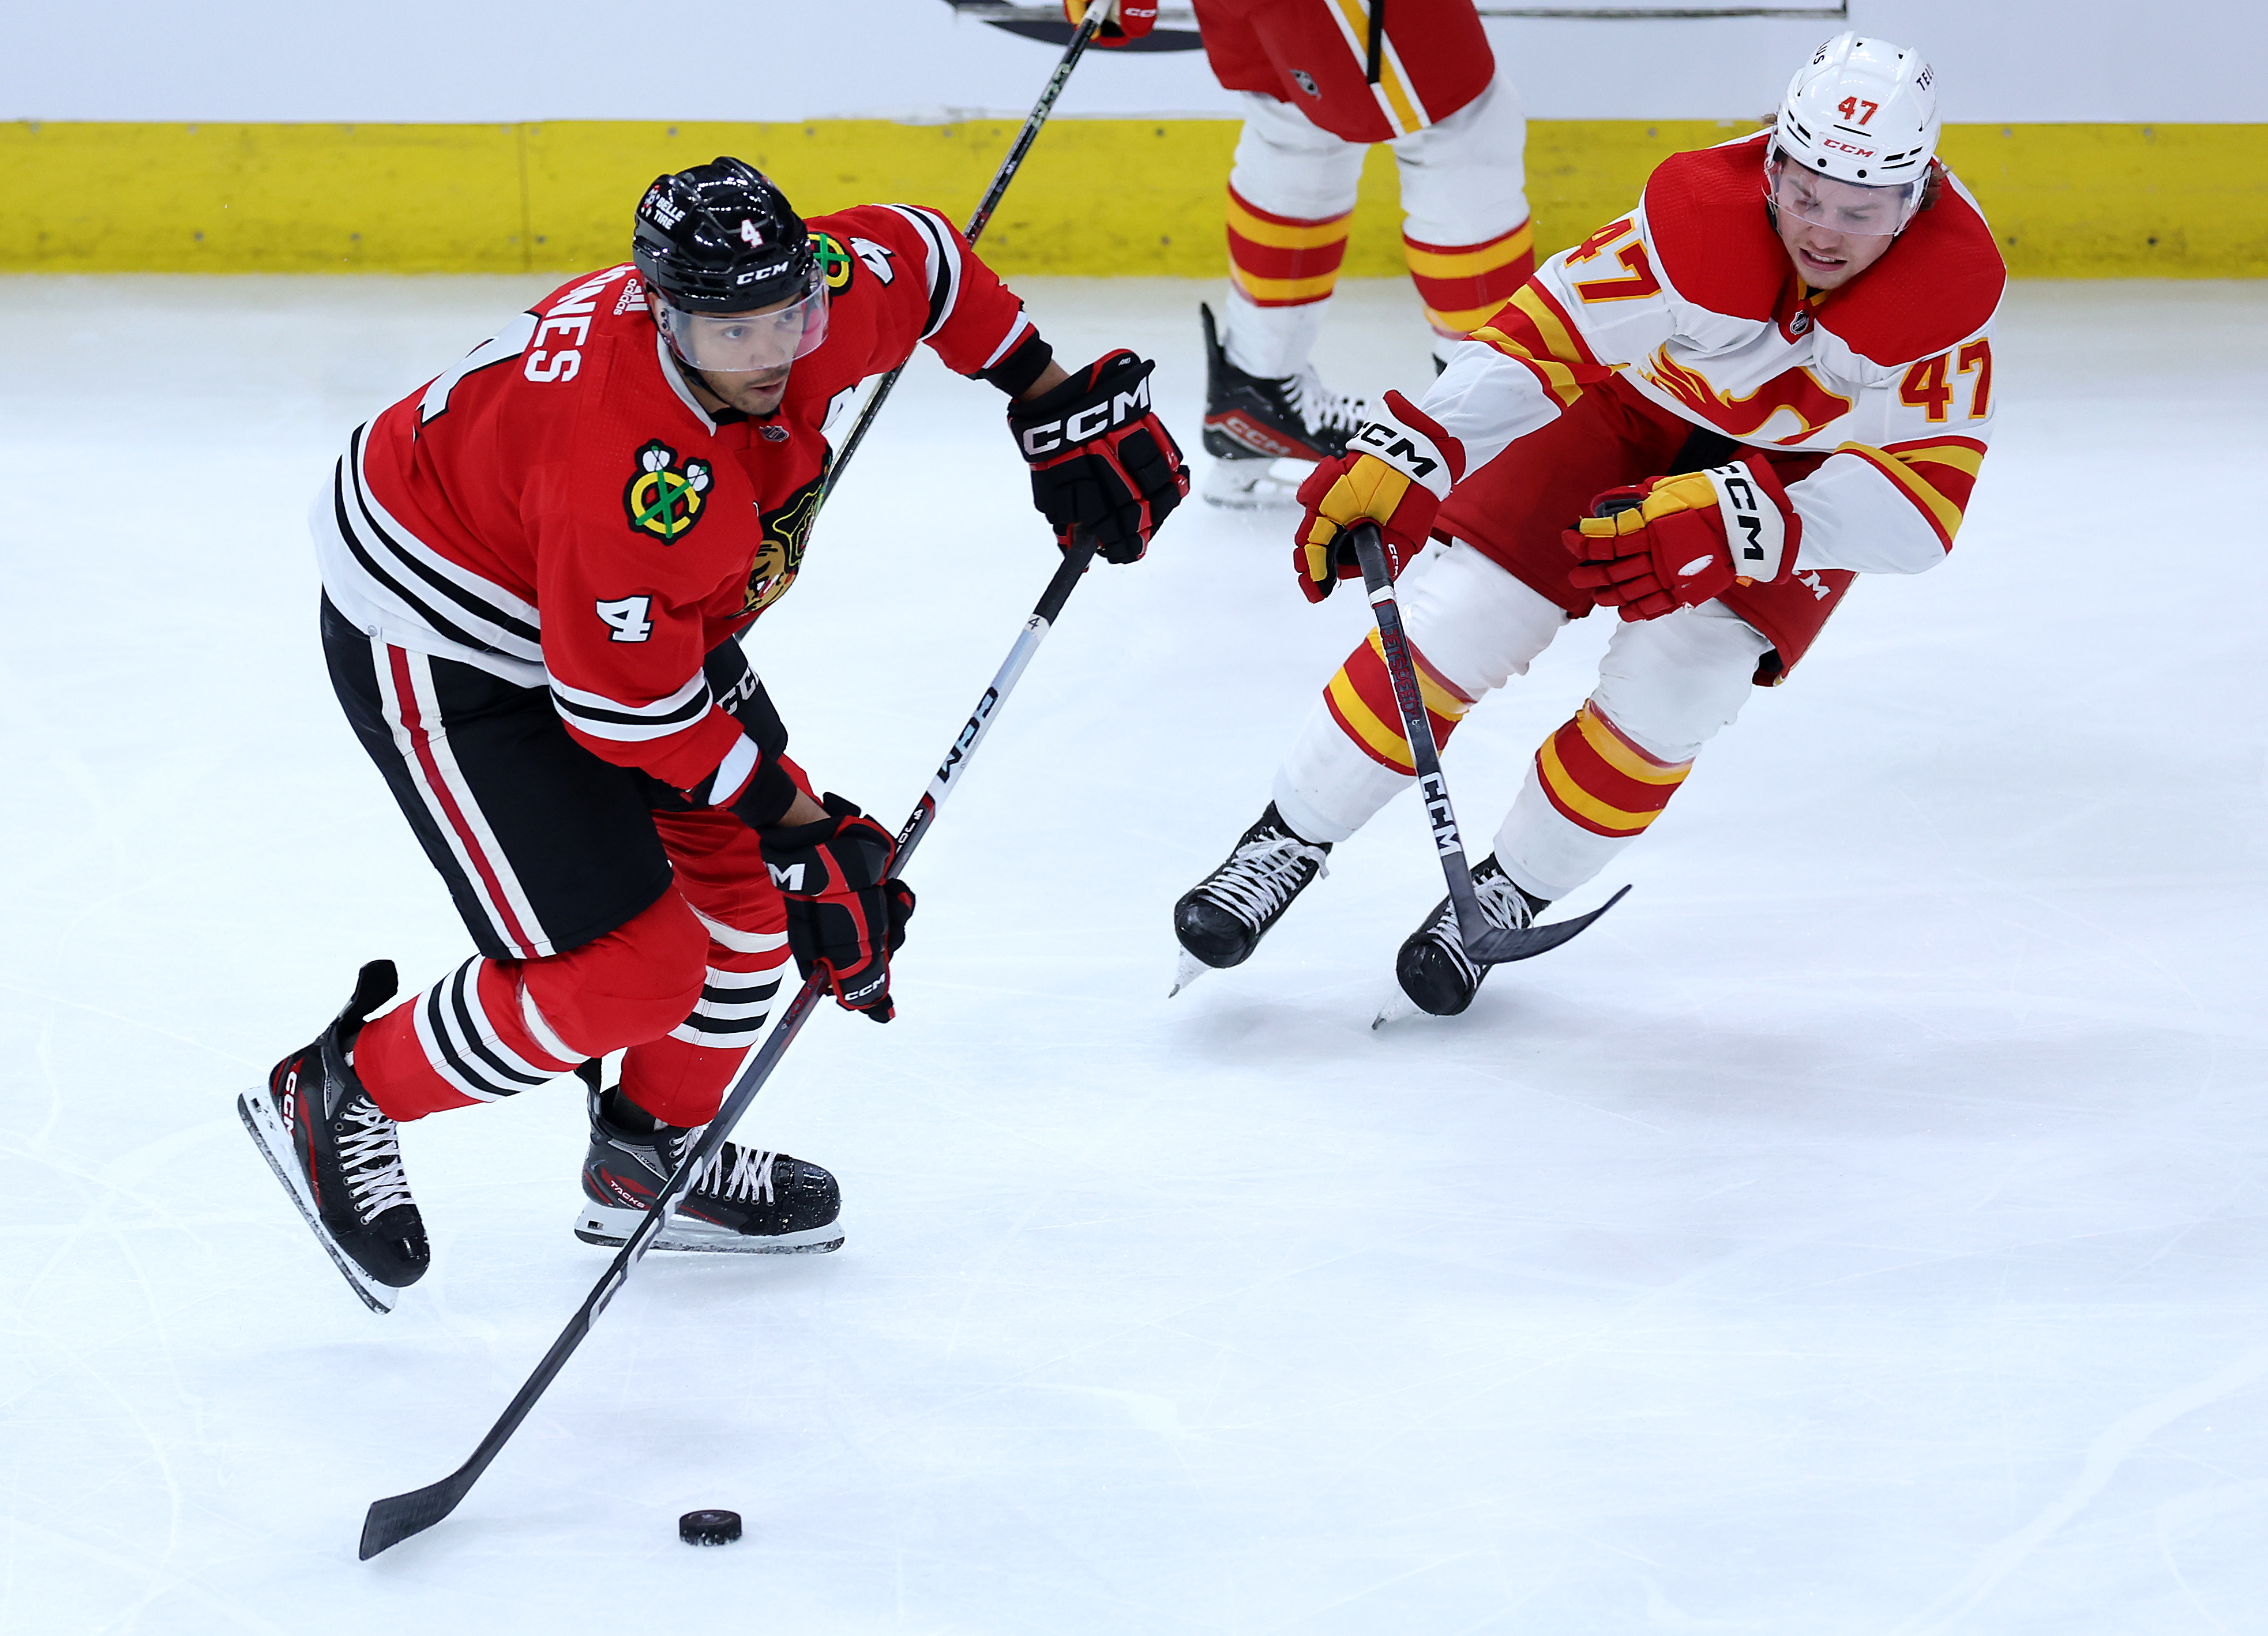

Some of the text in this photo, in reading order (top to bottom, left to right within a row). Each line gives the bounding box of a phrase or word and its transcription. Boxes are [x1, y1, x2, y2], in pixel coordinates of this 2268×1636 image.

[1838, 96, 1879, 126] 47
[1823, 138, 1874, 157] CCM
[654, 209, 675, 230] TIRE
[656, 197, 686, 222] BELLE
[740, 219, 764, 249] 4
[736, 261, 790, 285] CCM
[1564, 217, 1662, 304] 47
[613, 279, 637, 315] adidas
[1898, 337, 1992, 422] 47
[1023, 375, 1149, 456] CCM
[1352, 422, 1438, 479] CM
[595, 595, 654, 642] 4
[1028, 617, 1040, 630] 4
[1381, 628, 1419, 712] JETSPEED
[716, 666, 760, 716] CC
[937, 686, 999, 784] CCM
[1420, 772, 1463, 857] CCM
[844, 972, 886, 1001] CCM
[611, 1180, 645, 1208] TACKS
